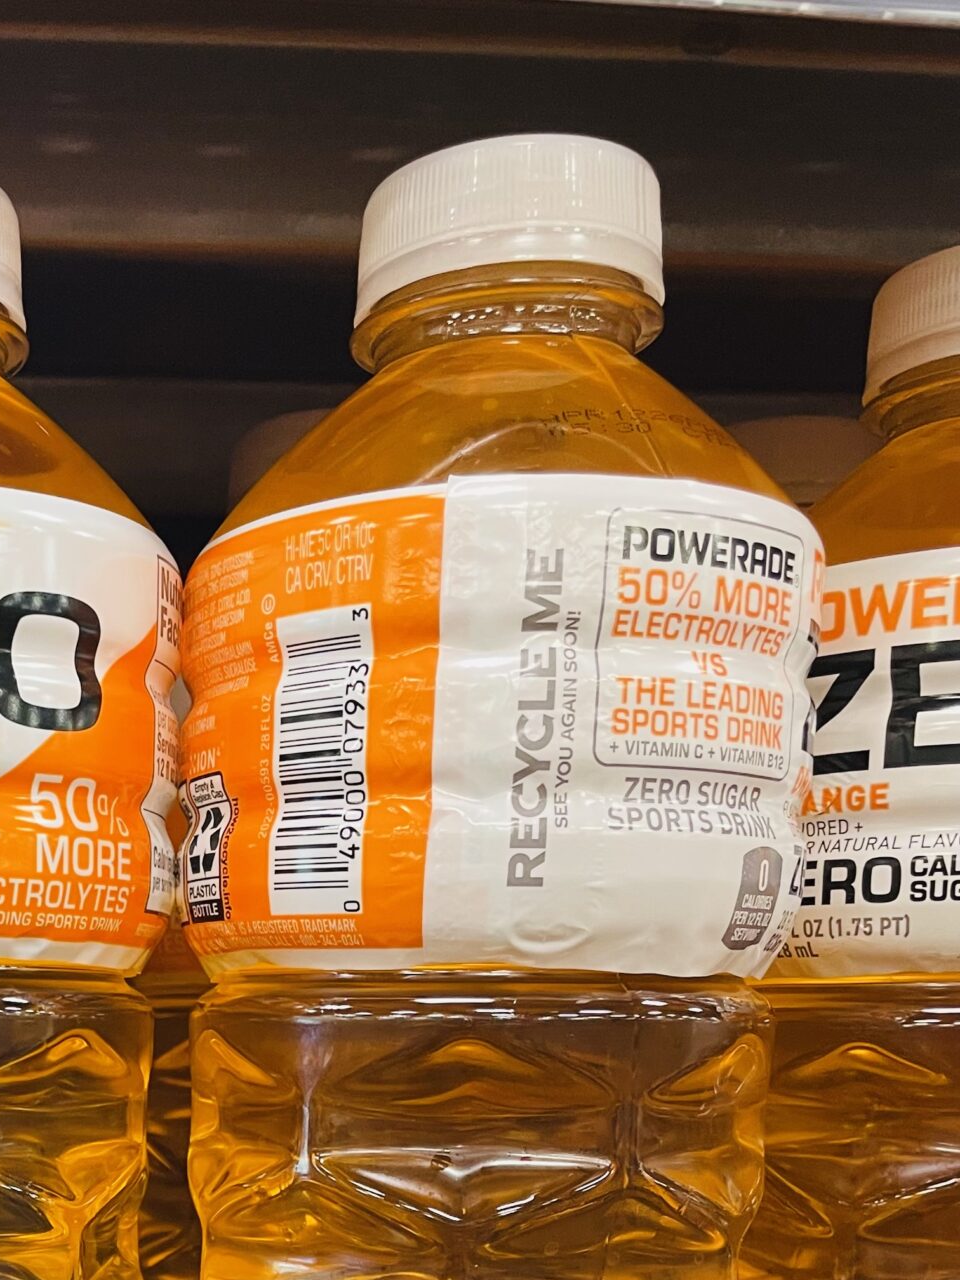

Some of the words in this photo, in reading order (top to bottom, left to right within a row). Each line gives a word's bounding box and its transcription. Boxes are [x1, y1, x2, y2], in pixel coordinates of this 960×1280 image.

[622, 526, 795, 585] POWERADE
[521, 548, 564, 632] ME
[618, 566, 701, 609] 50%
[714, 576, 792, 627] MORE
[352, 607, 369, 621] 3
[611, 609, 784, 657] ELECTROLYTES
[564, 610, 581, 673] SOON!
[343, 663, 369, 754] 07933
[561, 678, 577, 741] AGAIN
[615, 677, 675, 706] THE
[686, 682, 783, 720] LEADING
[611, 708, 718, 740] SPORTS
[727, 717, 782, 750] DRINK
[507, 647, 557, 887] RECYCLE
[555, 747, 572, 789] YOU
[625, 741, 690, 759] VITAMIN
[694, 744, 703, 759] C
[720, 746, 765, 767] VITAMIN
[768, 753, 784, 770] B12
[30, 773, 129, 837] 50%
[340, 771, 366, 860] 49000
[555, 793, 568, 828] SEE
[623, 777, 690, 805] ZERO
[698, 781, 761, 812] SUGAR
[36, 834, 131, 881] MORE
[36, 914, 86, 930] SPORTS
[90, 917, 122, 932] DRINK
[343, 900, 361, 913] 0
[804, 919, 823, 937] OZ
[829, 916, 873, 939] (1.75
[880, 914, 910, 937] PT)
